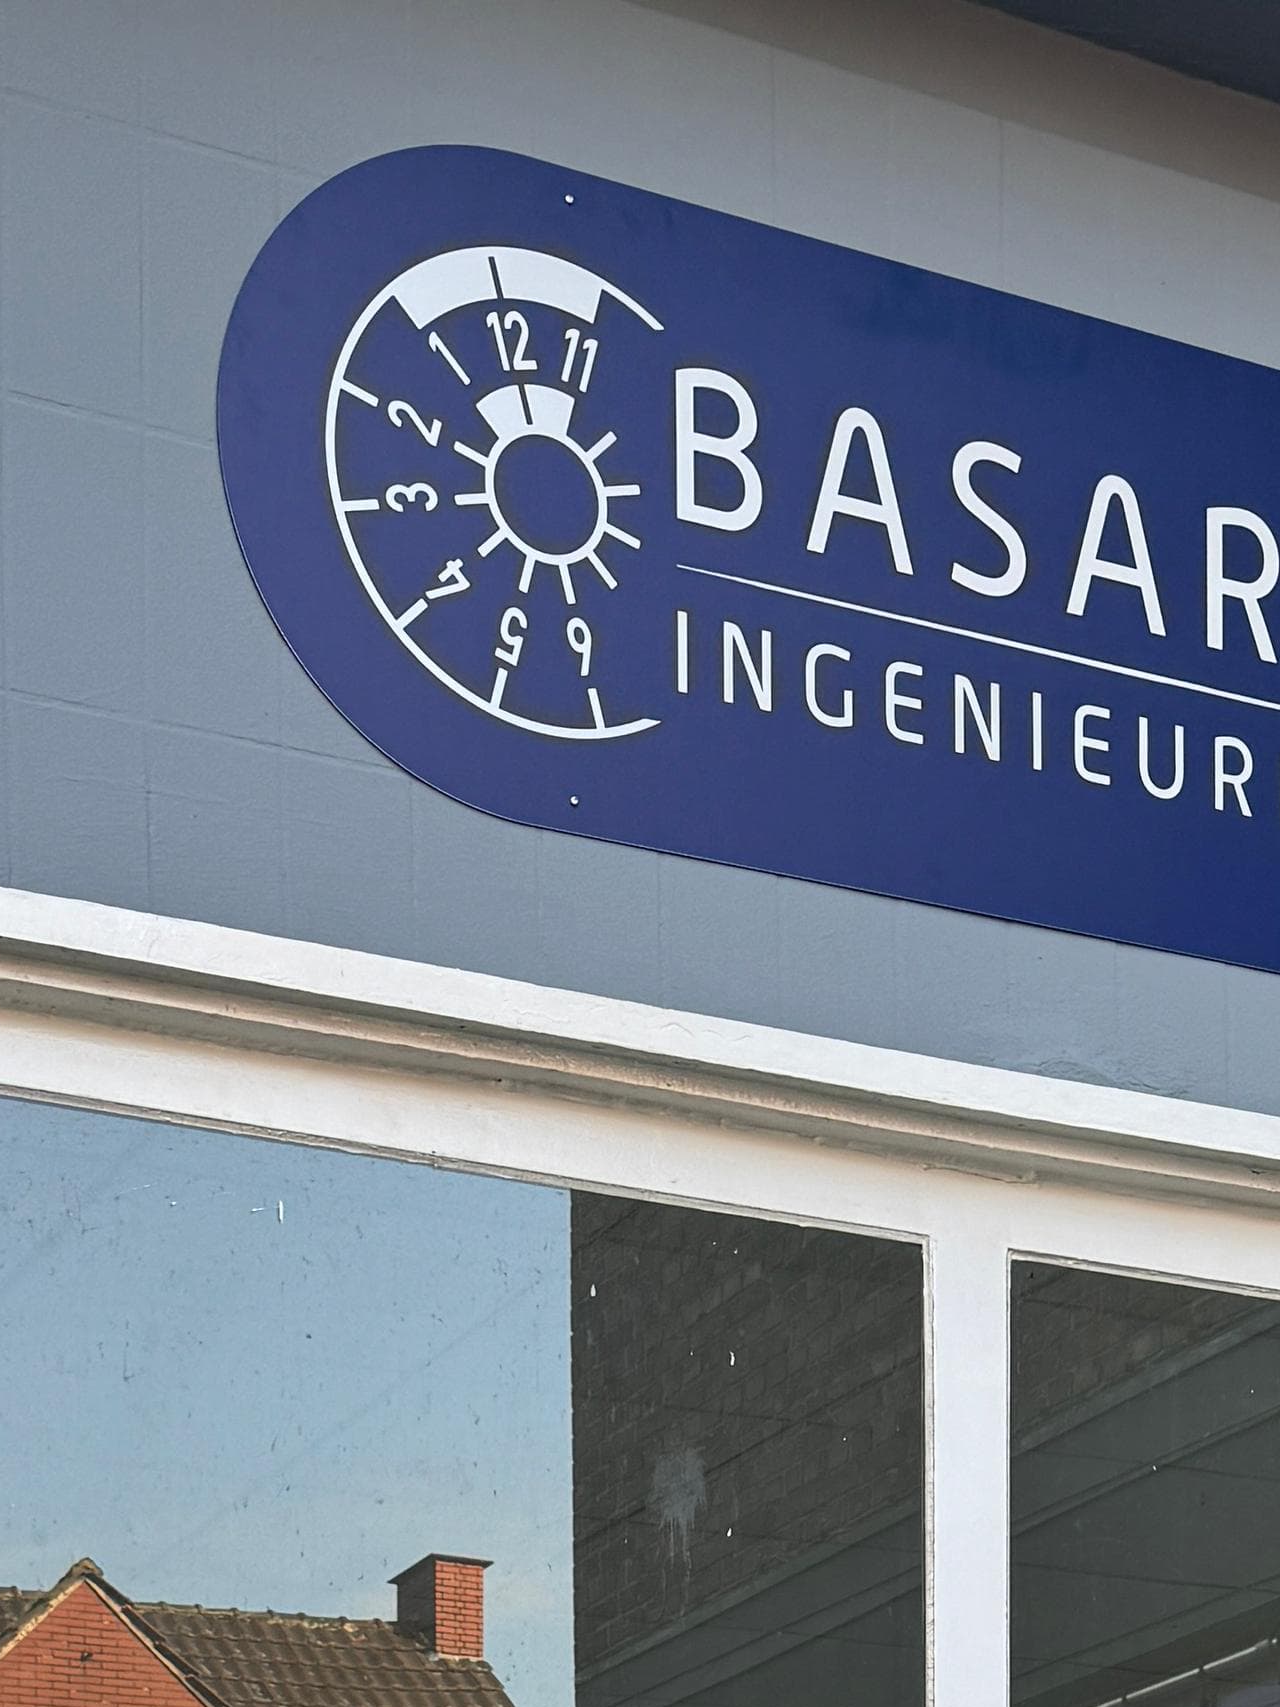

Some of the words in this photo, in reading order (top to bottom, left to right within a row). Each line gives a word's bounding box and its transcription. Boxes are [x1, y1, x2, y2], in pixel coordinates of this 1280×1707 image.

[428, 331, 471, 386] 1
[485, 310, 538, 371] 12
[560, 328, 598, 393] 11
[387, 399, 442, 446] 2
[385, 482, 438, 512] 3
[426, 558, 471, 600] 4
[495, 606, 528, 667] 5
[566, 617, 592, 676] 6
